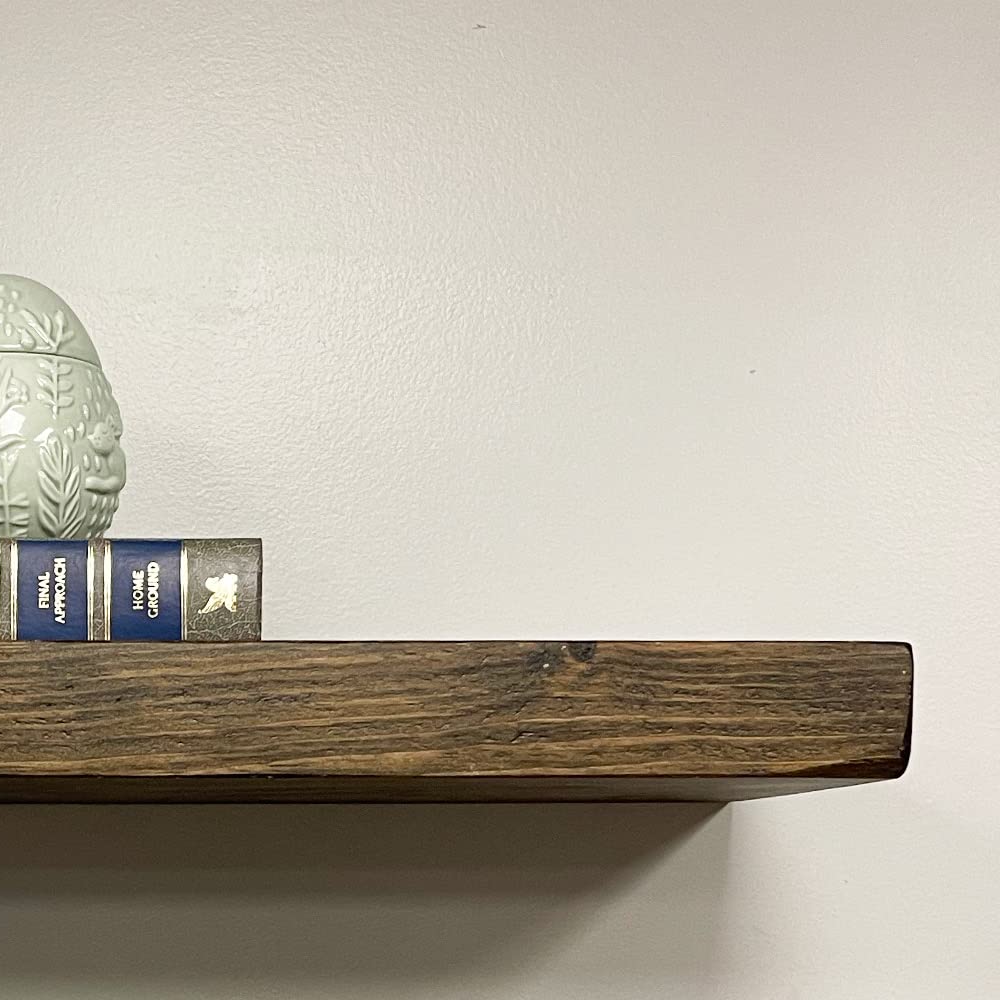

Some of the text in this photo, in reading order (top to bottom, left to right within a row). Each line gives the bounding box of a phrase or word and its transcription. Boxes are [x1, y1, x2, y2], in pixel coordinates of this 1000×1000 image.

[37, 571, 50, 609] FINAL
[53, 557, 66, 624] APPROACH
[132, 569, 145, 611] HOME
[147, 561, 160, 619] GROUND
